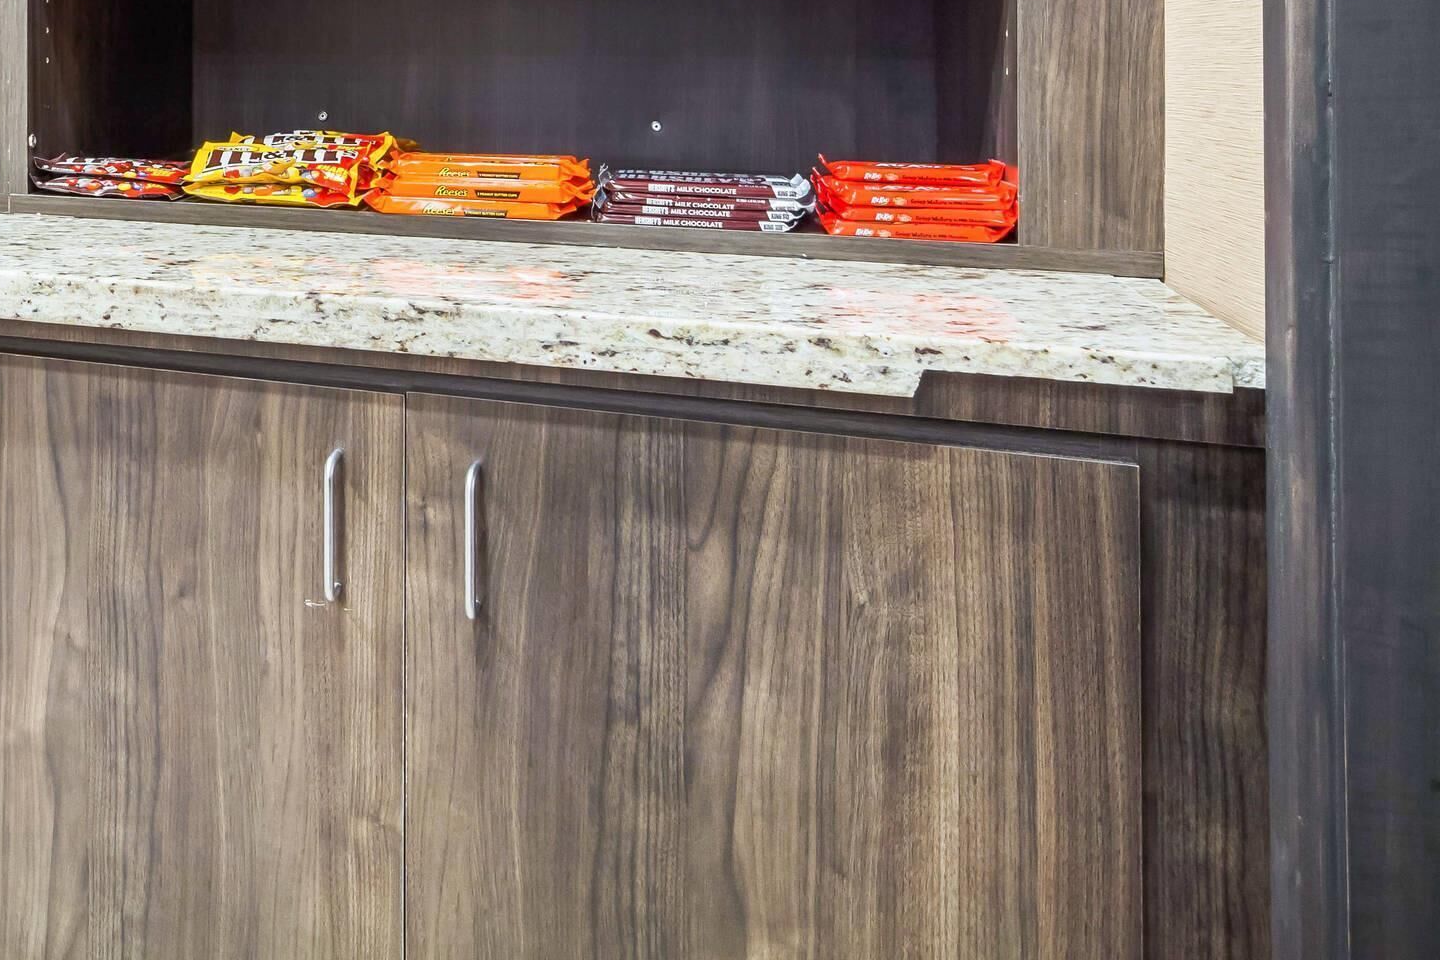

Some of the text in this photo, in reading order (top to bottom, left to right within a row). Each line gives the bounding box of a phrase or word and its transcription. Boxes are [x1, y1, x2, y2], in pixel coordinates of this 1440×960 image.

[694, 186, 737, 195] CHOCOLATE
[692, 201, 735, 210] CHOCOLATE
[688, 208, 731, 217] CHOCOLATE
[680, 220, 723, 228] CHOCOLATE
